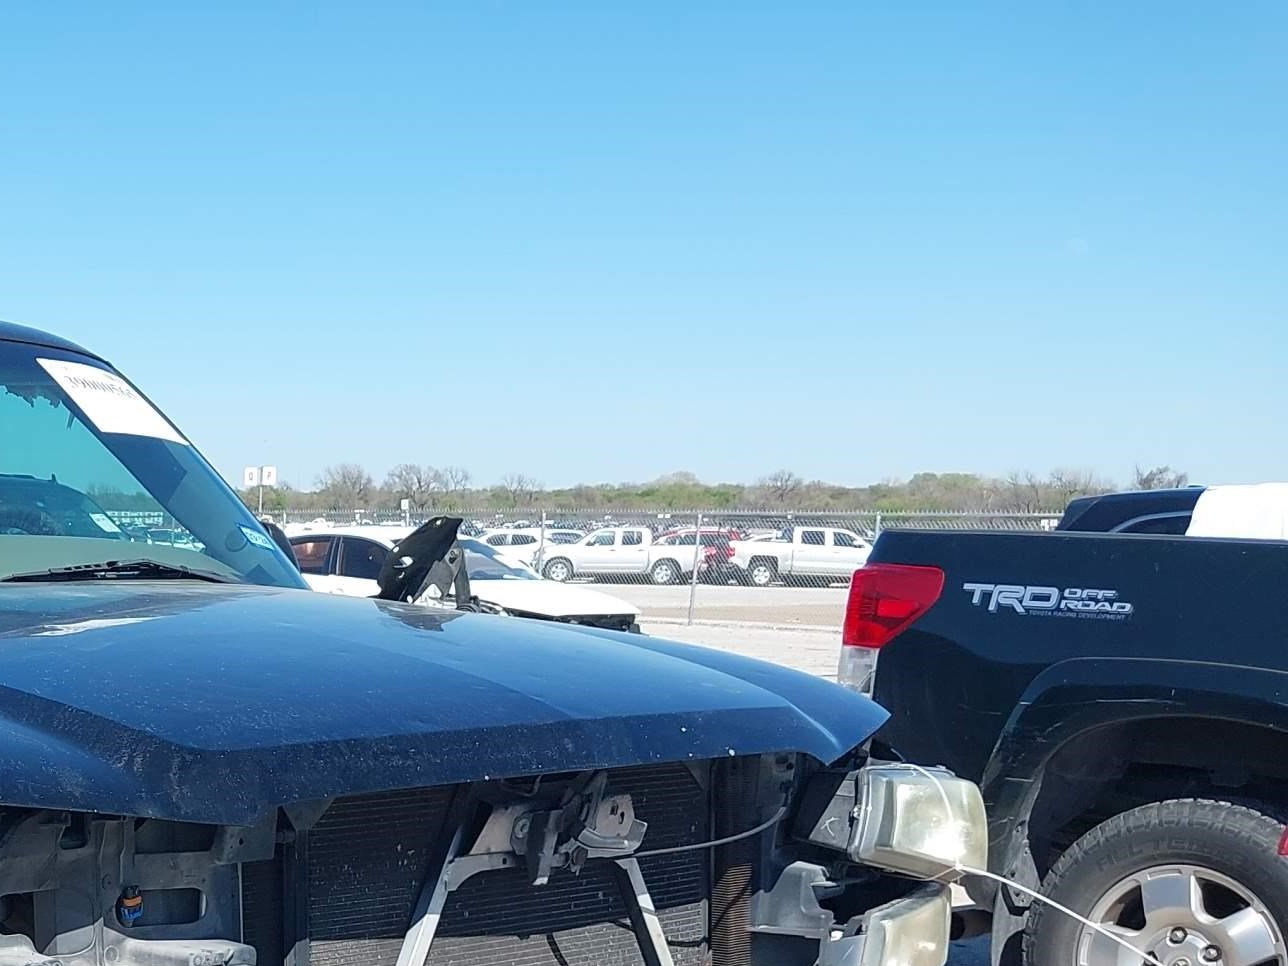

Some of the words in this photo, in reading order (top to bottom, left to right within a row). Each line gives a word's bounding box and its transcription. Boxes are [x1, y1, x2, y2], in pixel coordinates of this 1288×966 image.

[963, 583, 1060, 615] TRD
[1063, 588, 1117, 600] OFF
[1060, 600, 1133, 614] ROAD
